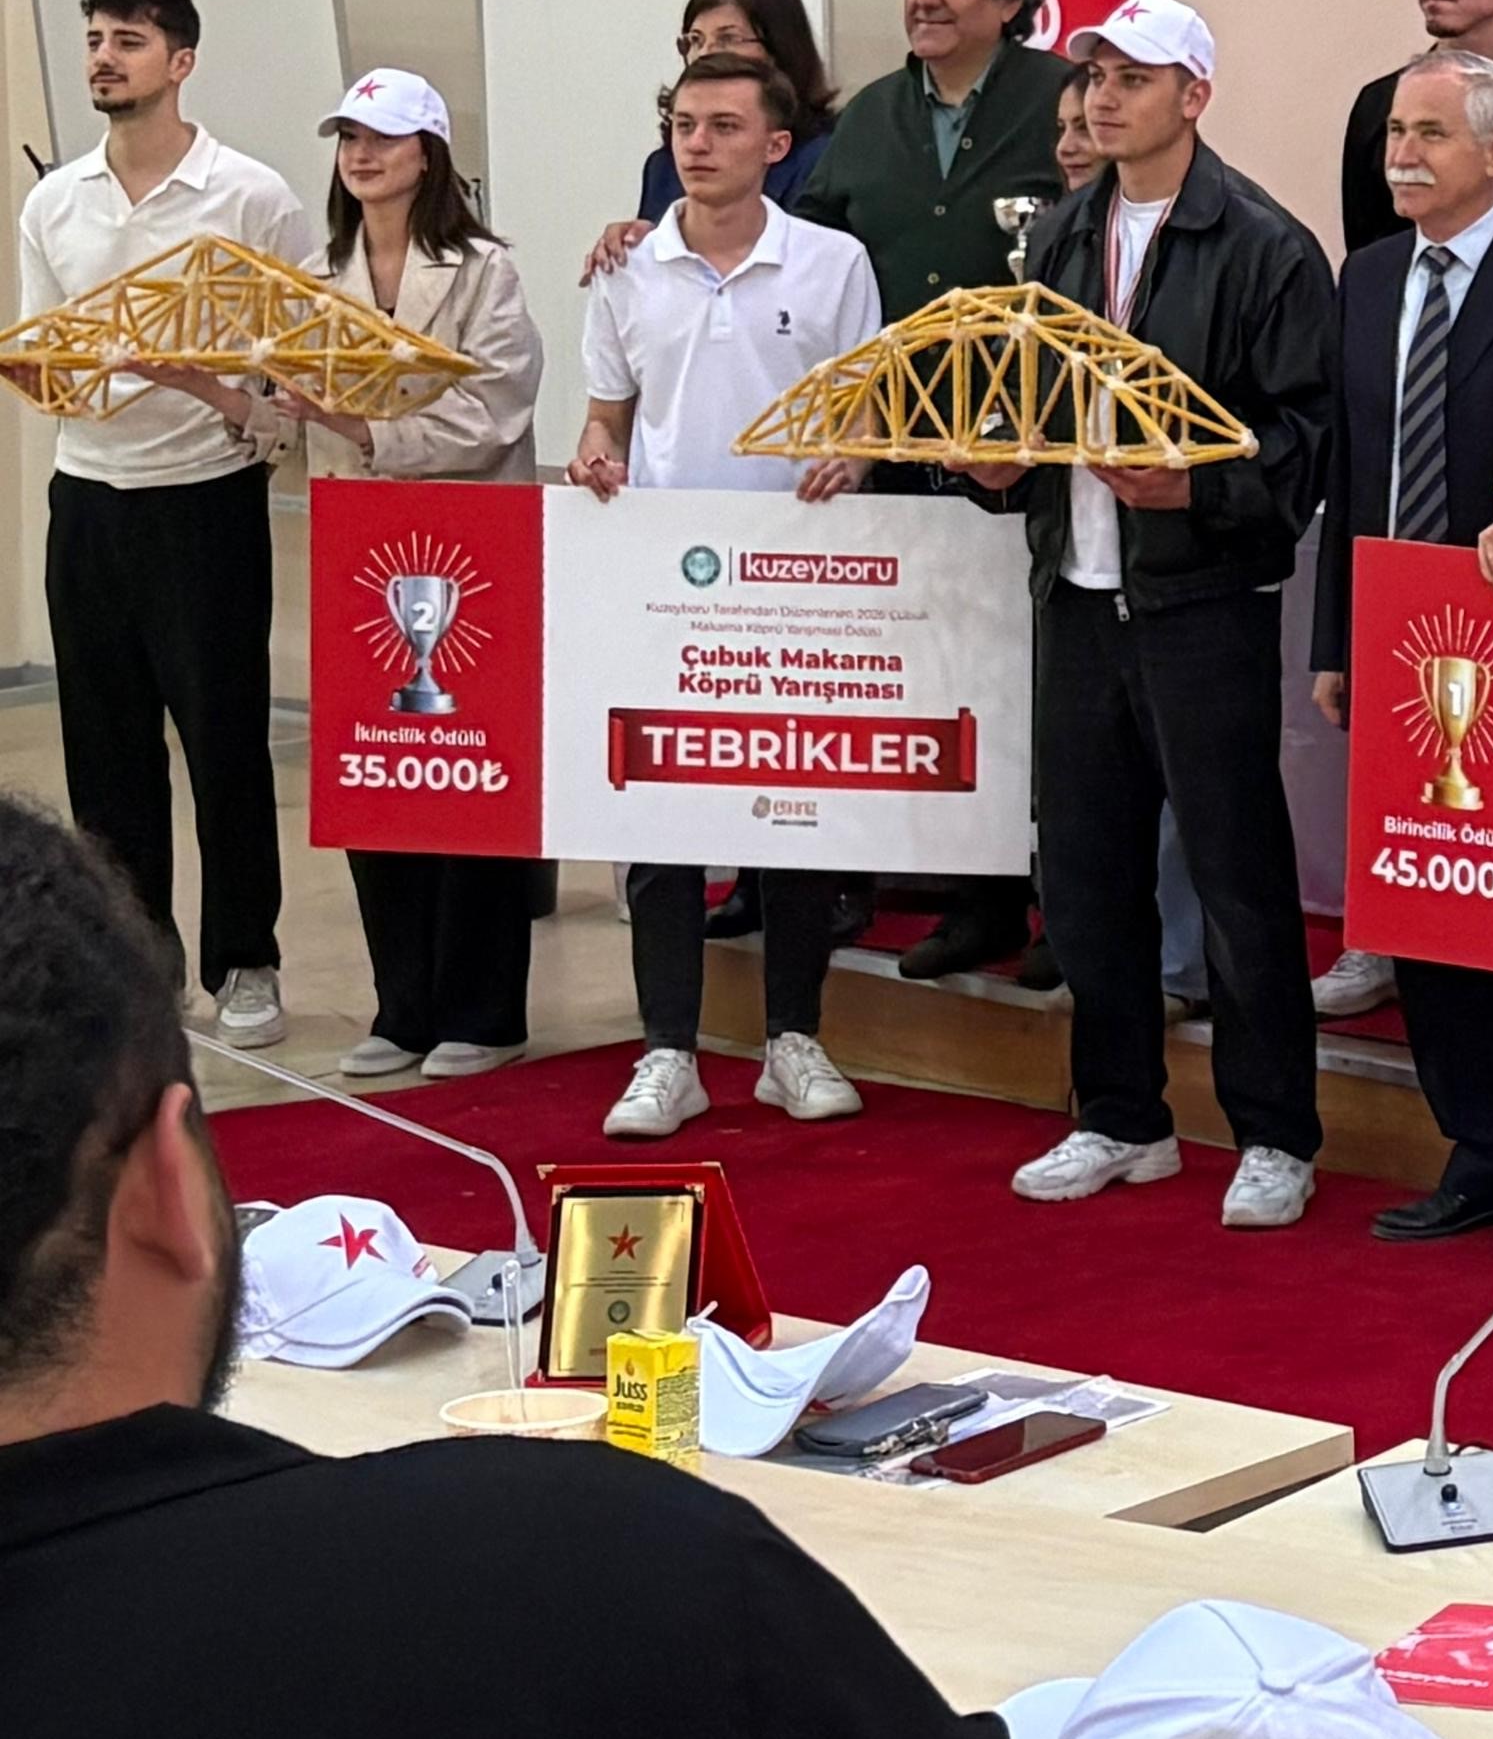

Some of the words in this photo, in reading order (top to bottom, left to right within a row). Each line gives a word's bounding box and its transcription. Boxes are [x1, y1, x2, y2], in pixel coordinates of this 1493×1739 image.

[745, 552, 893, 584] kuzeyboru
[411, 601, 436, 632] 2
[681, 645, 771, 671] Çubuk
[780, 648, 903, 672] Makarna
[678, 671, 762, 699] Köprü
[770, 676, 904, 703] Yarışması
[1447, 682, 1464, 716] 1
[354, 720, 426, 744] İkincilik
[430, 725, 487, 747] Ödülü
[641, 718, 941, 776] TEBRİKLER
[338, 752, 509, 793] 35.000₺
[1383, 815, 1457, 842] Birincilik
[613, 1373, 649, 1401] Juss
